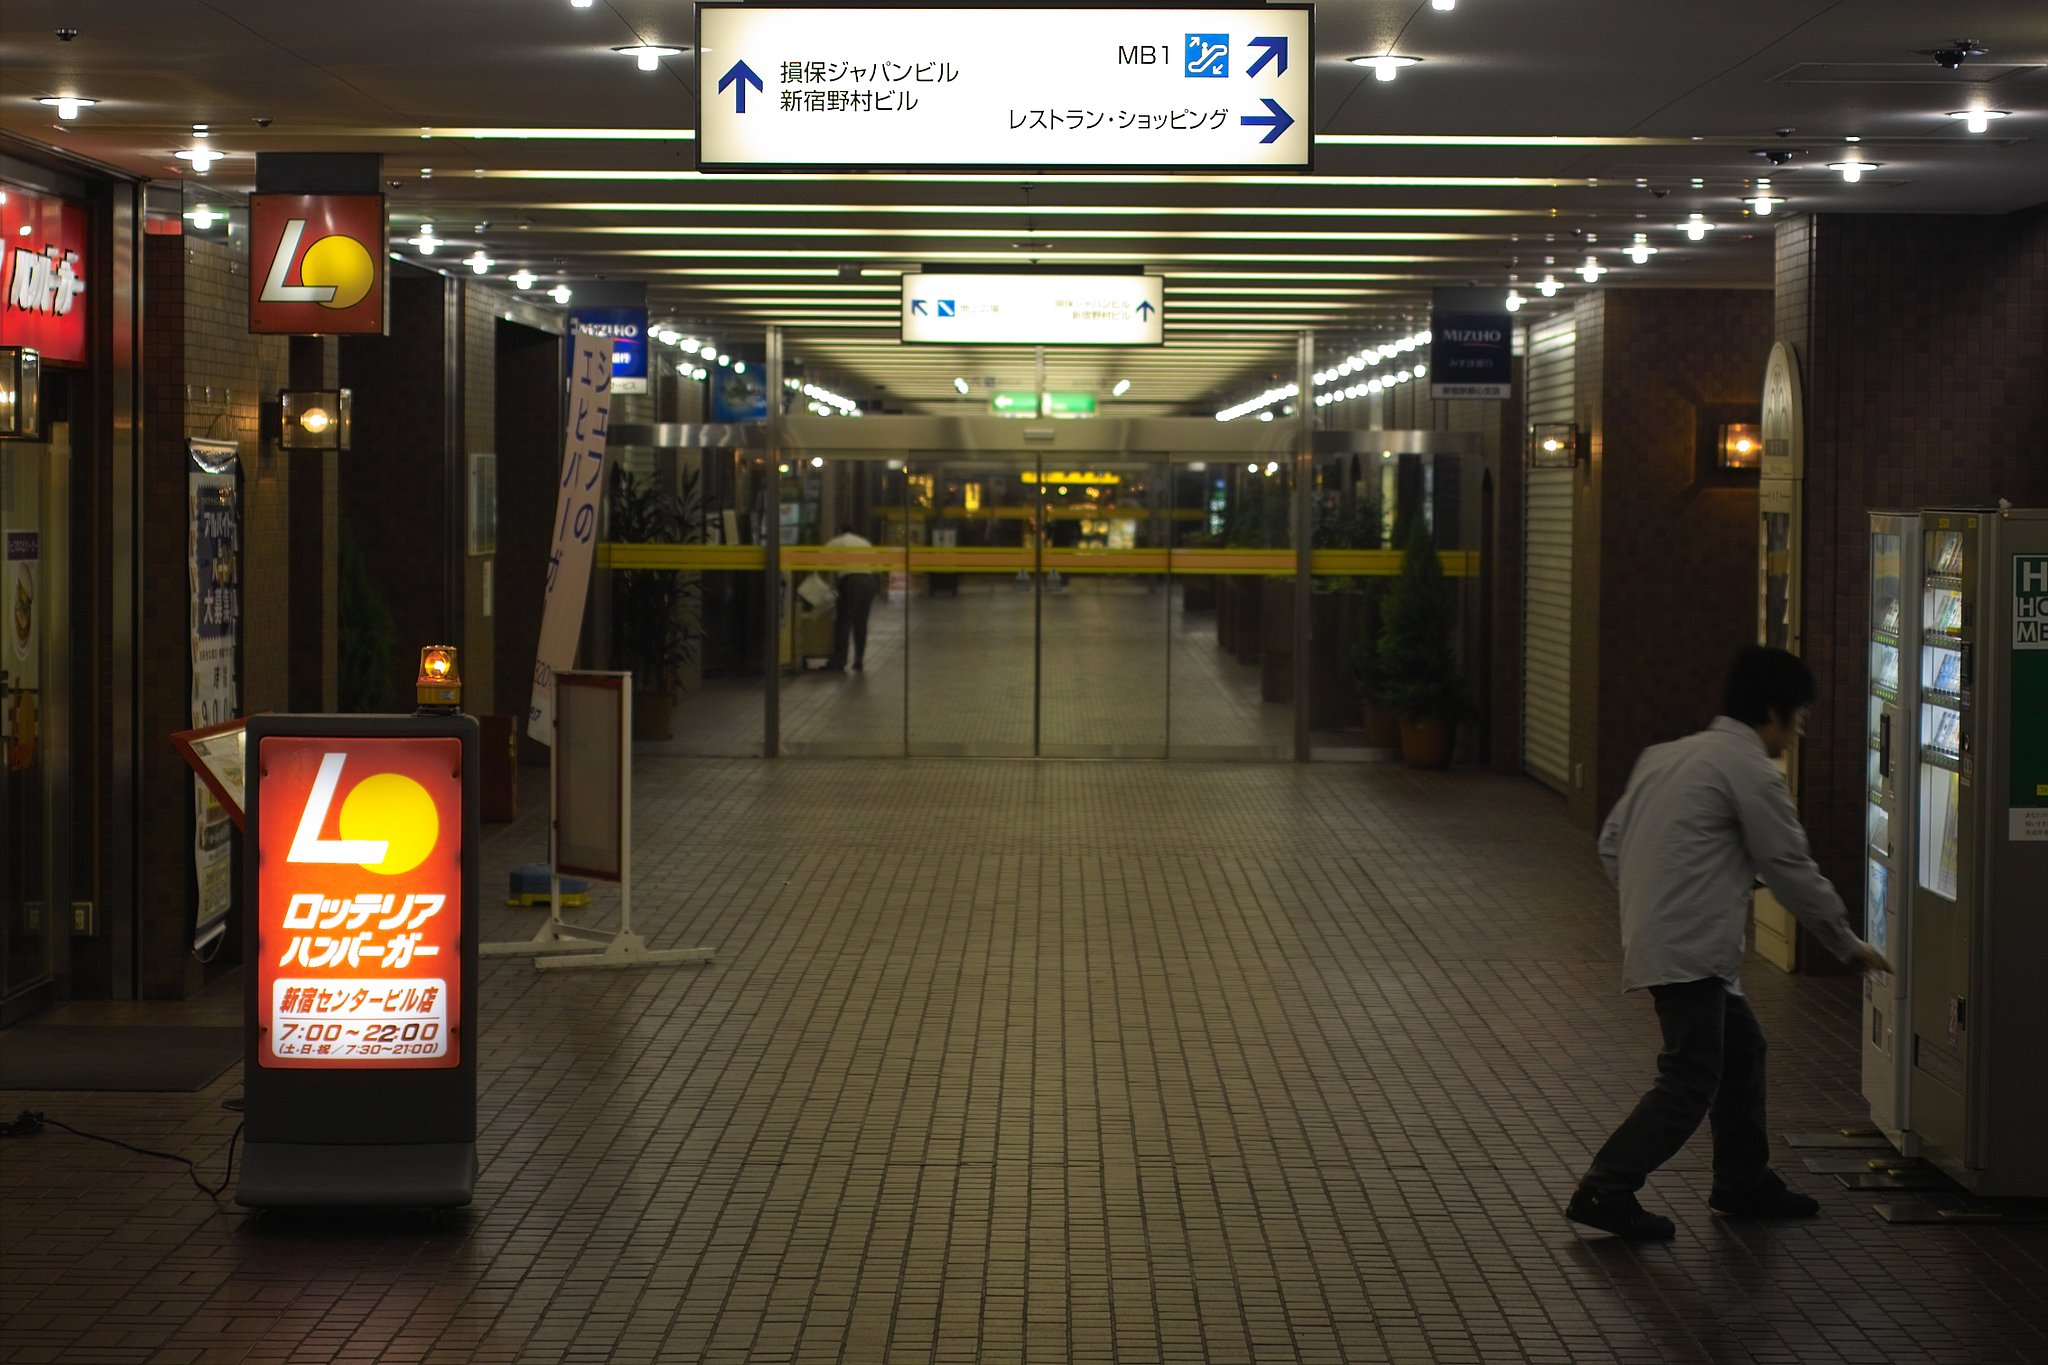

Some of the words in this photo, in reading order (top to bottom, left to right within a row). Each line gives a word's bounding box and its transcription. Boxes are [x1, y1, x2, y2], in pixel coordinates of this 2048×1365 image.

[1117, 45, 1171, 65] MB1
[779, 60, 959, 84] 損保ジャパンビル
[779, 89, 918, 112] 新宿野村ビル
[1009, 107, 1229, 131] レストラン・ショッピング
[1443, 329, 1502, 342] MIZUHO
[281, 893, 447, 930] ロッテリア
[279, 932, 440, 969] ハンバーガー
[279, 986, 439, 1014] 新宿センタービル店
